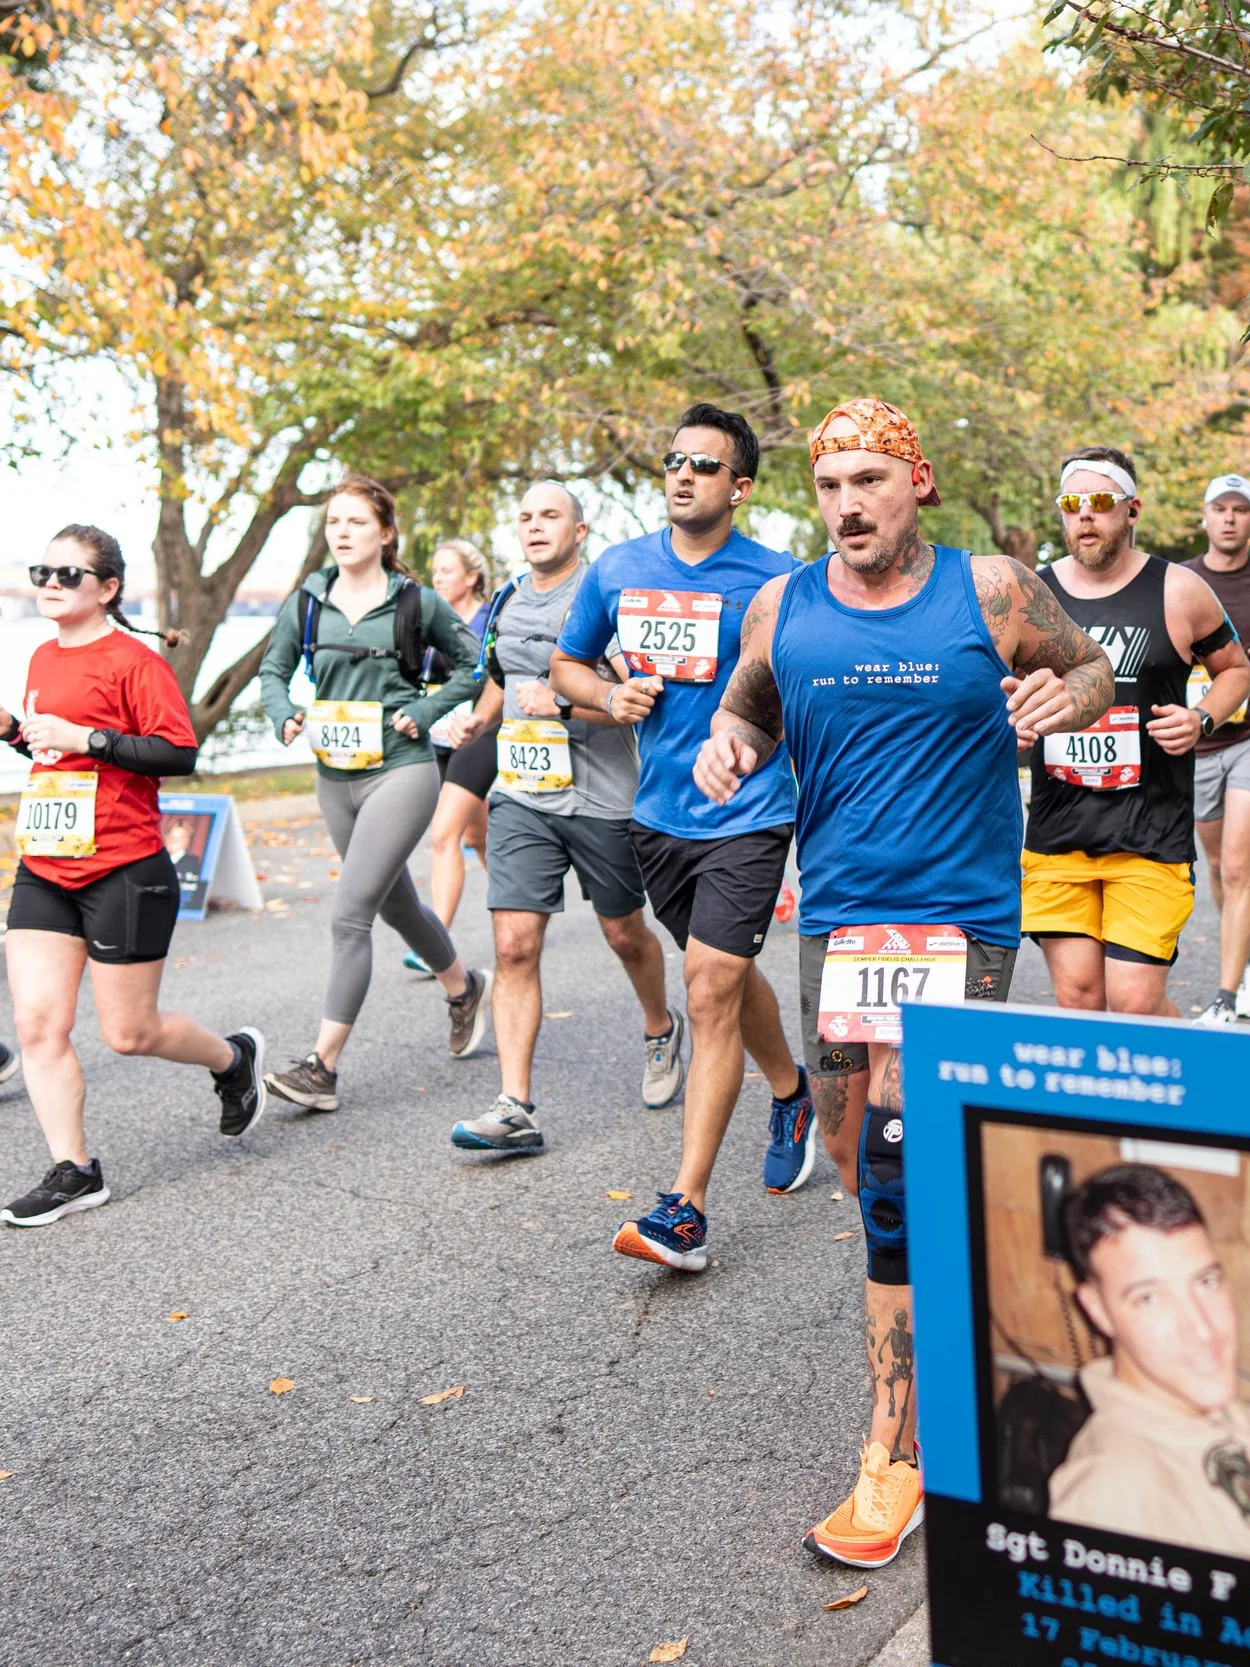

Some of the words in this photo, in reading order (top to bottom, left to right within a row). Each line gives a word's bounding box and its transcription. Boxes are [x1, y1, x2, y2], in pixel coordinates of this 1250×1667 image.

[640, 620, 697, 652] 2525
[812, 675, 835, 687] run
[843, 674, 859, 685] to
[866, 673, 939, 685] remember
[855, 663, 890, 672] wear
[898, 661, 940, 672] blue:
[321, 725, 362, 748] 8424
[1066, 735, 1117, 763] 4108
[510, 744, 551, 771] 8423
[26, 802, 77, 830] 10179
[856, 967, 930, 1007] 1167
[1013, 1041, 1086, 1069] wear
[1096, 1044, 1183, 1079] blue:
[937, 1060, 989, 1085] run
[999, 1062, 1036, 1090] to
[1044, 1070, 1187, 1106] remember
[985, 1522, 1049, 1563] Sgt
[1063, 1538, 1193, 1593] Donnie
[1209, 1569, 1237, 1601] F
[1017, 1569, 1143, 1625] Killed
[1158, 1602, 1203, 1638] in
[1020, 1611, 1061, 1643] 17
